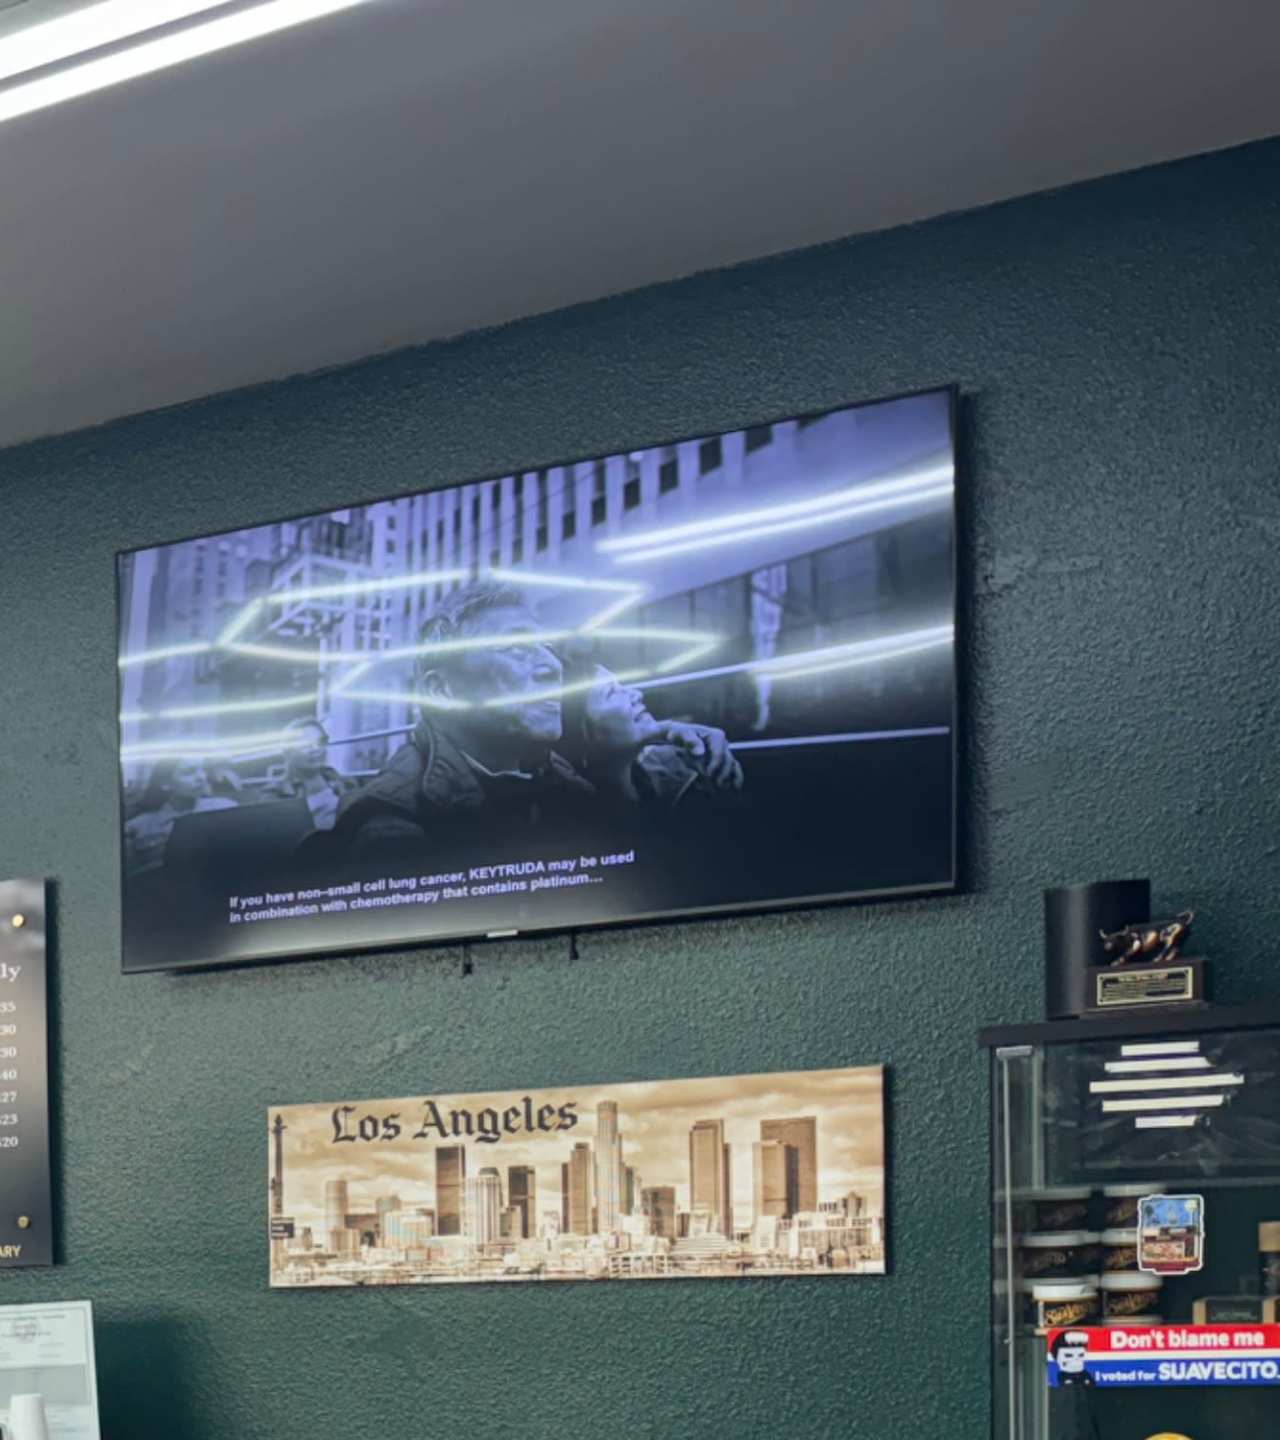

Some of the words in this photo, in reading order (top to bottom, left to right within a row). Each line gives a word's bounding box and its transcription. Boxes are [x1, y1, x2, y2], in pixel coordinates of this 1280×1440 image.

[230, 896, 238, 908] If
[240, 895, 263, 909] you
[266, 892, 294, 904] have
[363, 880, 385, 893] cell
[388, 876, 417, 890] lung
[420, 872, 466, 886] cancer,
[469, 862, 545, 880] KEYTRUDA
[548, 858, 576, 872] may
[580, 855, 597, 868] be
[601, 850, 634, 865] used
[230, 912, 241, 923] in
[244, 904, 319, 921] combination
[321, 900, 348, 912] with
[350, 892, 439, 910] chemotherapy
[443, 887, 467, 899] that
[471, 880, 527, 896] contains
[332, 1105, 401, 1144] Los
[413, 1096, 578, 1144] Angeles
[1110, 1330, 1164, 1349] Don't
[1168, 1329, 1229, 1348] blame
[1233, 1331, 1265, 1347] me
[1101, 1371, 1136, 1382] voted
[1138, 1370, 1156, 1381] for
